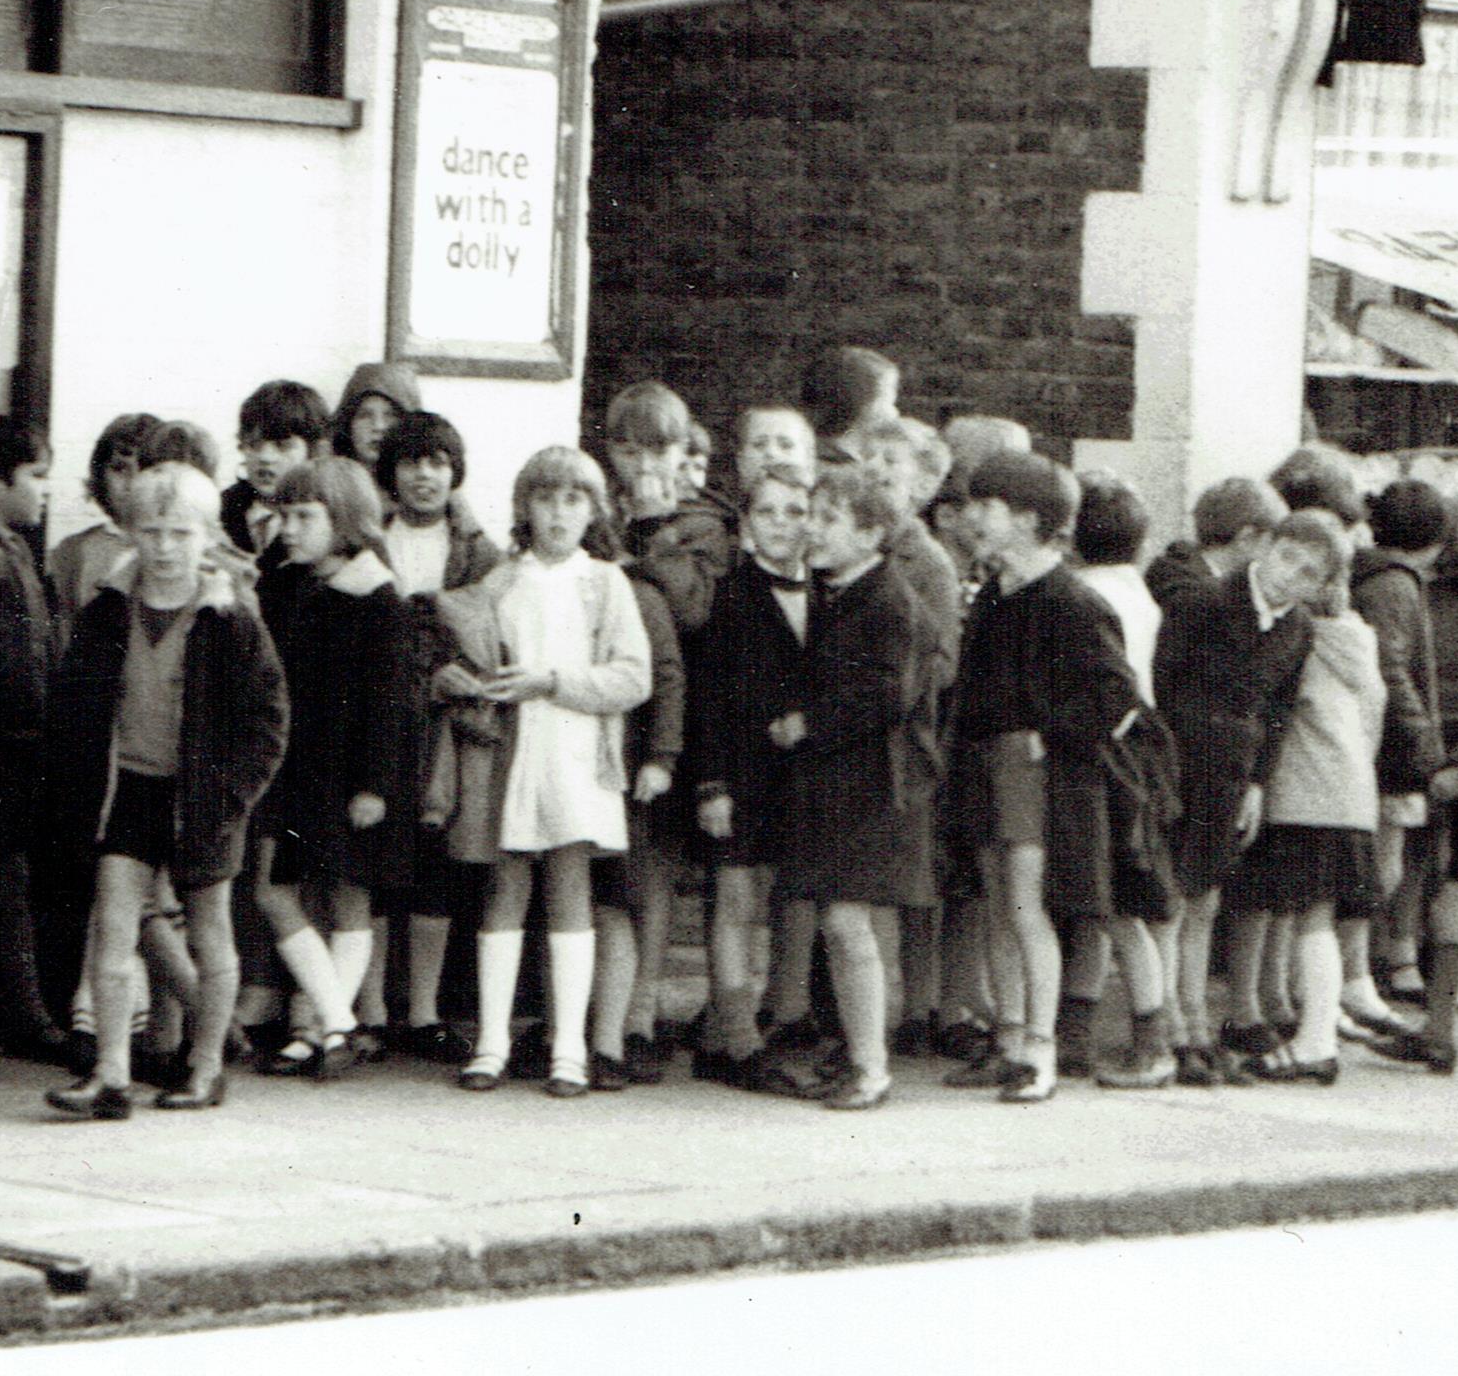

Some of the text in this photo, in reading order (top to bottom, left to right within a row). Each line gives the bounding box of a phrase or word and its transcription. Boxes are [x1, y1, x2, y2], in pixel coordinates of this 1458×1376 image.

[441, 136, 530, 181] dance
[434, 187, 533, 228] with a
[446, 233, 521, 278] dolly
